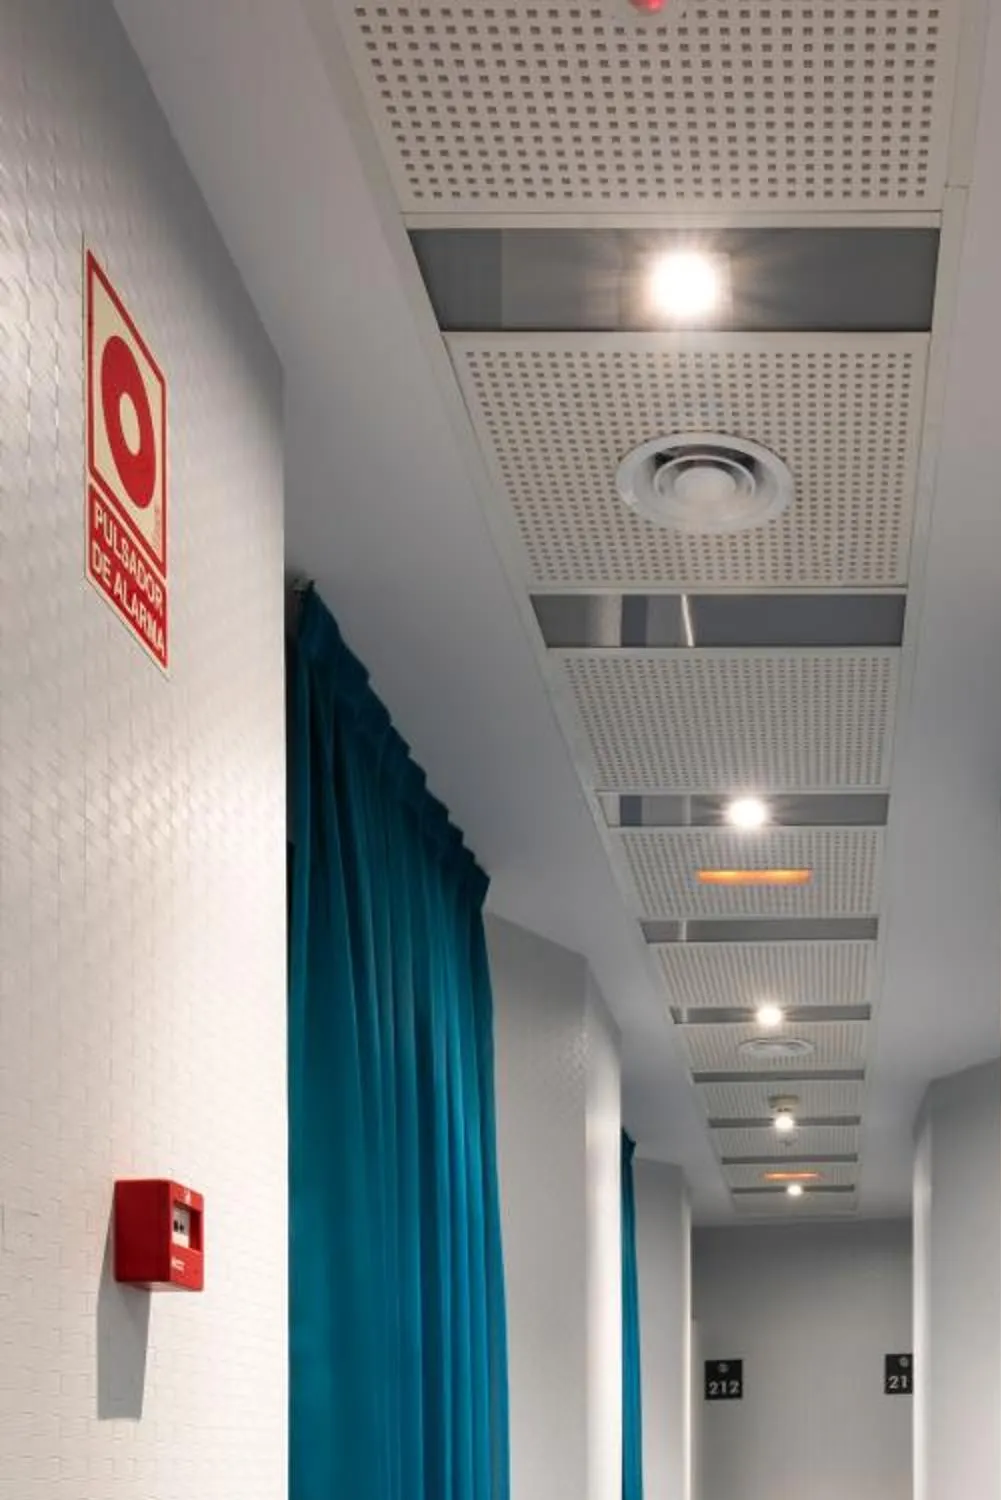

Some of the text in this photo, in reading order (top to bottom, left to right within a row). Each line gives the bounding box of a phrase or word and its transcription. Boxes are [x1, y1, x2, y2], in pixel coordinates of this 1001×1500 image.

[94, 502, 163, 616] PULSADOR
[92, 541, 165, 657] DE ALARMA
[709, 1381, 740, 1395] 212
[889, 1375, 908, 1389] 21
